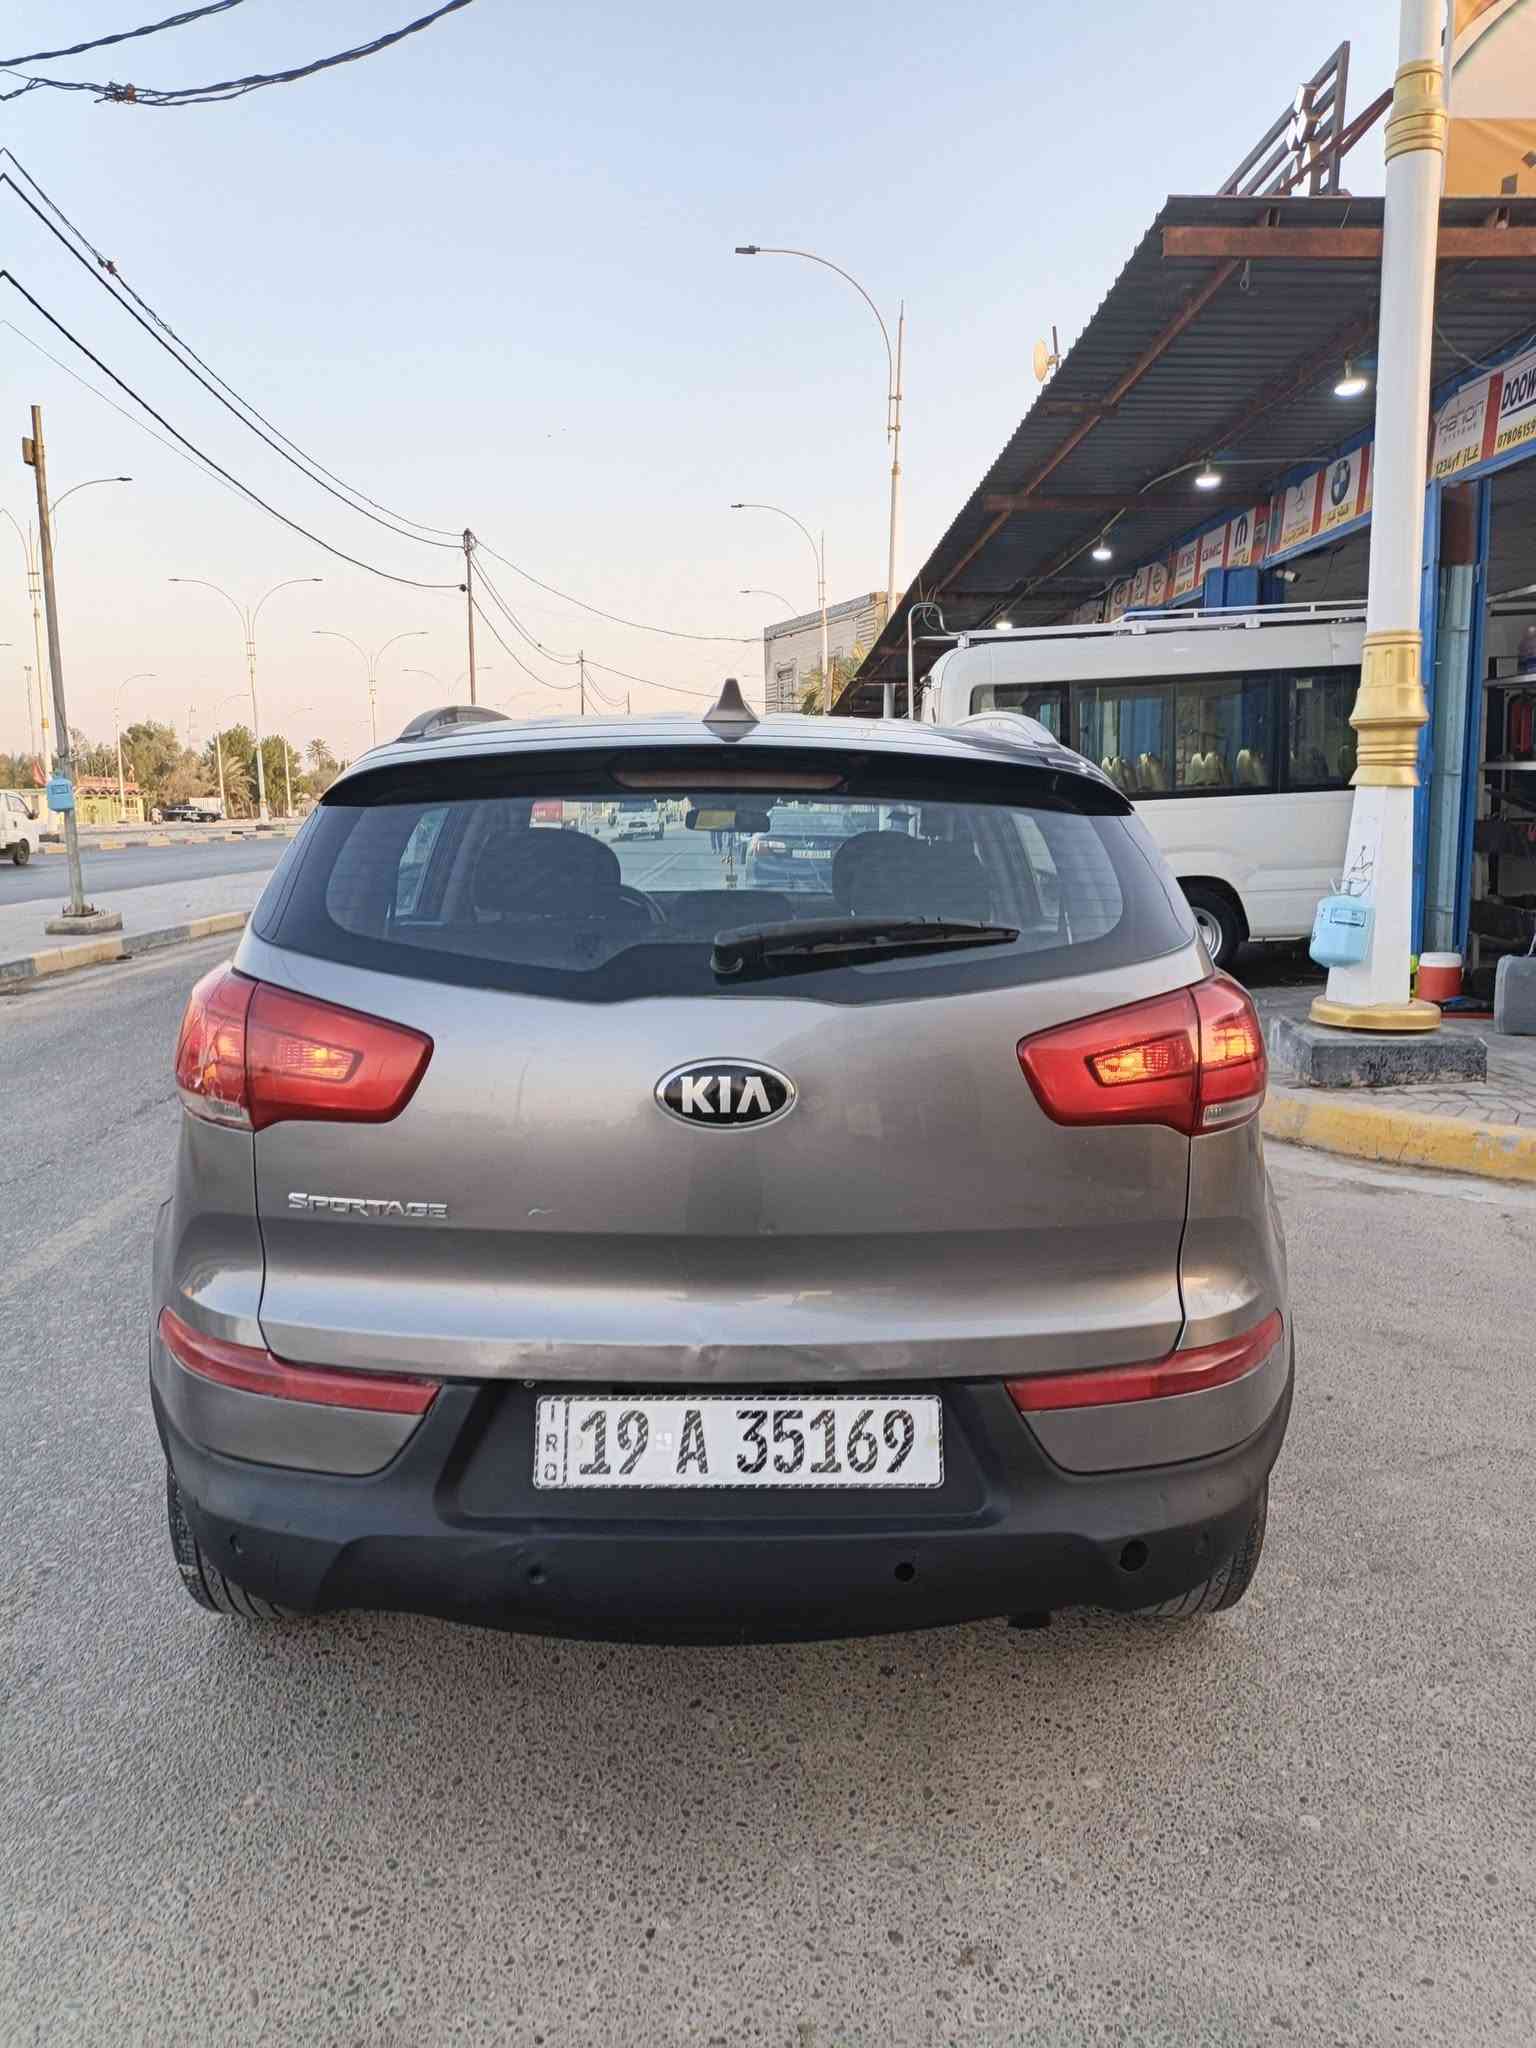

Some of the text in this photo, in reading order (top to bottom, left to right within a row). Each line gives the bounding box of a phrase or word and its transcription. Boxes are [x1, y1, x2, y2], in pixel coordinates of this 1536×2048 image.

[1202, 543, 1223, 561] GMC
[679, 1076, 772, 1113] KIA
[287, 1192, 448, 1218] SPORTAGE
[579, 1408, 915, 1475] 19 A 35169
